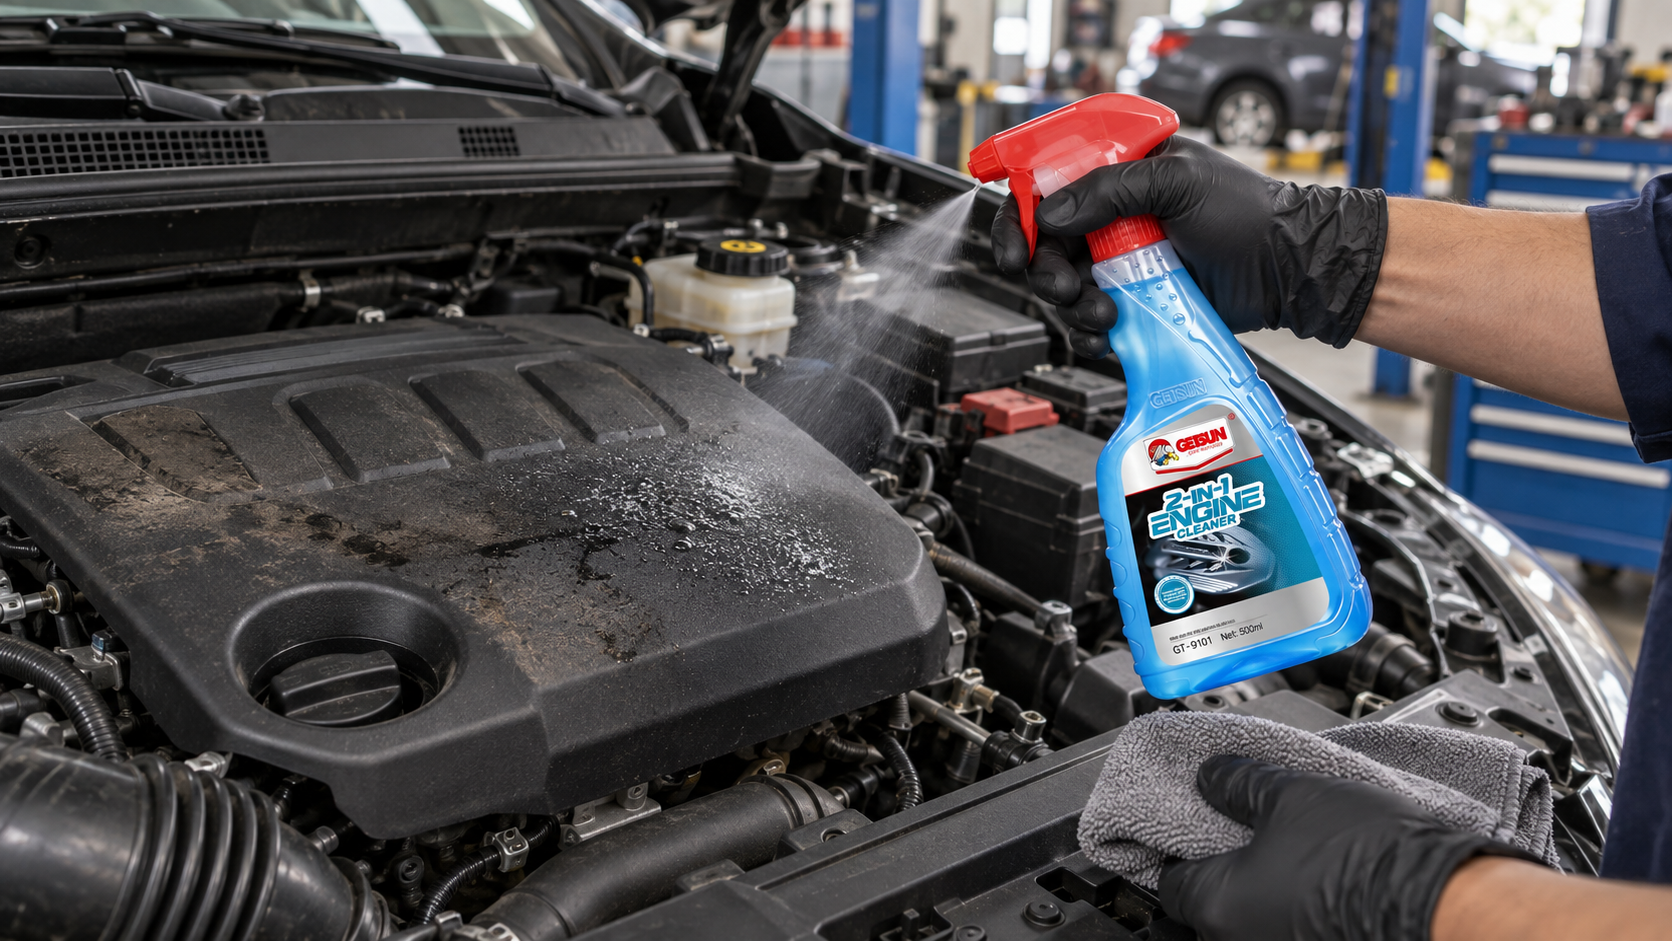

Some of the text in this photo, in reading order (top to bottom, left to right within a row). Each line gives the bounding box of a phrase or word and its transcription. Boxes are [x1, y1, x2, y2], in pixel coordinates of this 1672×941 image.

[1149, 378, 1207, 409] GETSUN
[1176, 426, 1228, 453] GETSUN
[1165, 476, 1230, 512] 2-IN-1
[1150, 485, 1262, 537] ENGINE
[1176, 513, 1237, 539] CLEANER
[1172, 636, 1213, 655] GT-9101
[1220, 630, 1238, 642] Net:
[1239, 622, 1263, 637] 500ml
